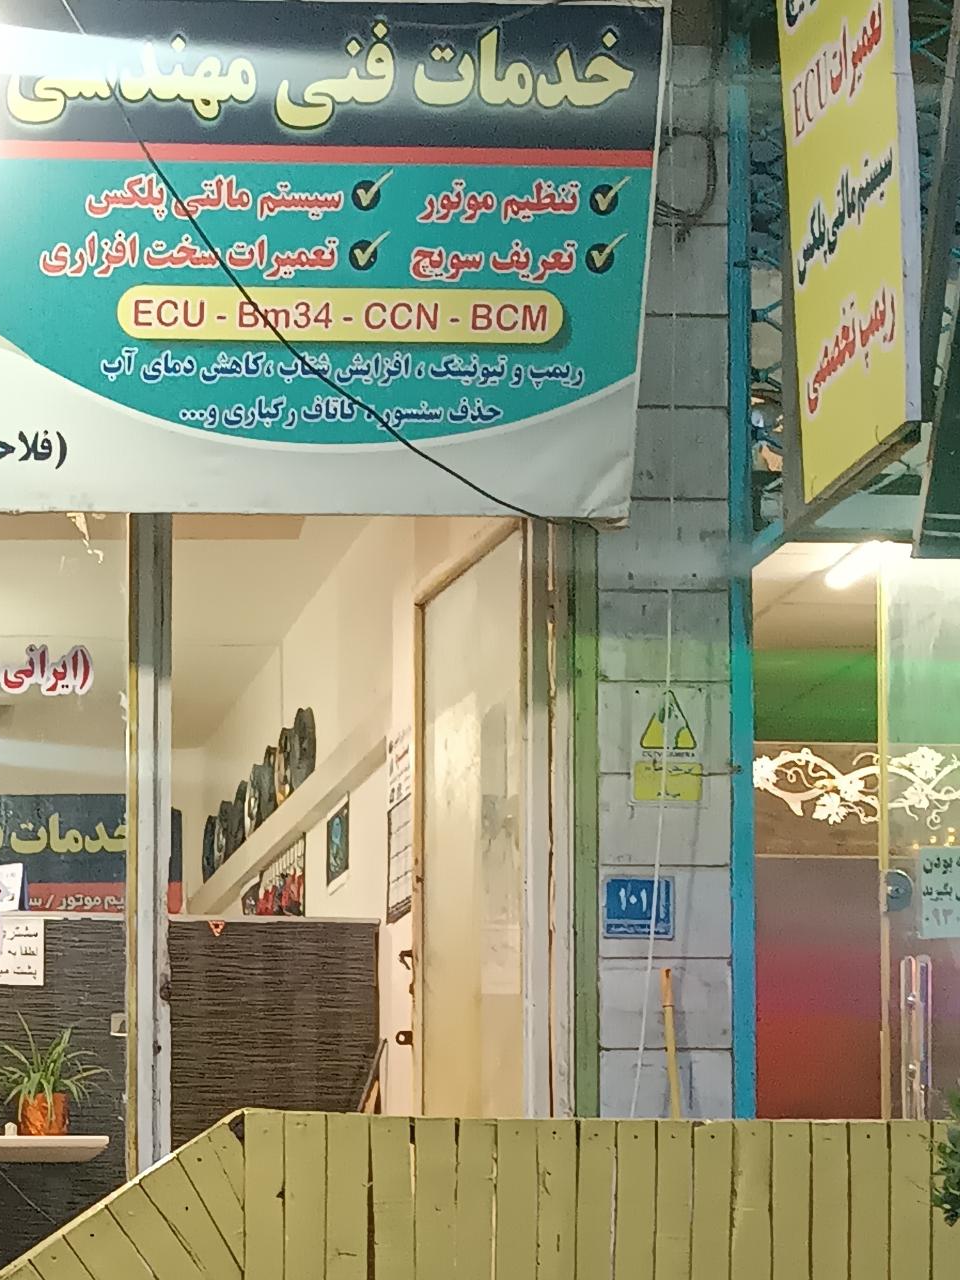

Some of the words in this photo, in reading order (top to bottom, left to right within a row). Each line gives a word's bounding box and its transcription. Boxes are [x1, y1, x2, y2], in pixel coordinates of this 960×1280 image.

[6, 33, 257, 125] مهندسی
[274, 18, 396, 130] فنی
[413, 27, 635, 109] خدمات
[792, 50, 828, 138] ECU
[85, 175, 166, 220] پلکس
[172, 175, 250, 217] مالتی
[258, 181, 343, 220] سیستم
[417, 180, 494, 223] موتور
[502, 181, 582, 222] تنظیم
[40, 232, 139, 282] افزاری
[143, 237, 221, 271] سخت
[226, 236, 338, 280] تعمیرات
[409, 242, 484, 282] سویچ
[490, 239, 576, 282] تعریف
[133, 298, 207, 328] ECU
[238, 300, 334, 331] Bm34
[363, 302, 439, 332] CCN
[470, 302, 549, 333] BCM
[101, 347, 138, 382] آب
[141, 351, 196, 383] دمای
[278, 352, 329, 383] شتاب
[335, 351, 411, 387] افزایش
[510, 364, 524, 386] و
[528, 359, 585, 389] ریمپ
[377, 400, 444, 430] سنسور
[447, 397, 503, 424] حذف
[618, 887, 648, 913] ۱۰۱
